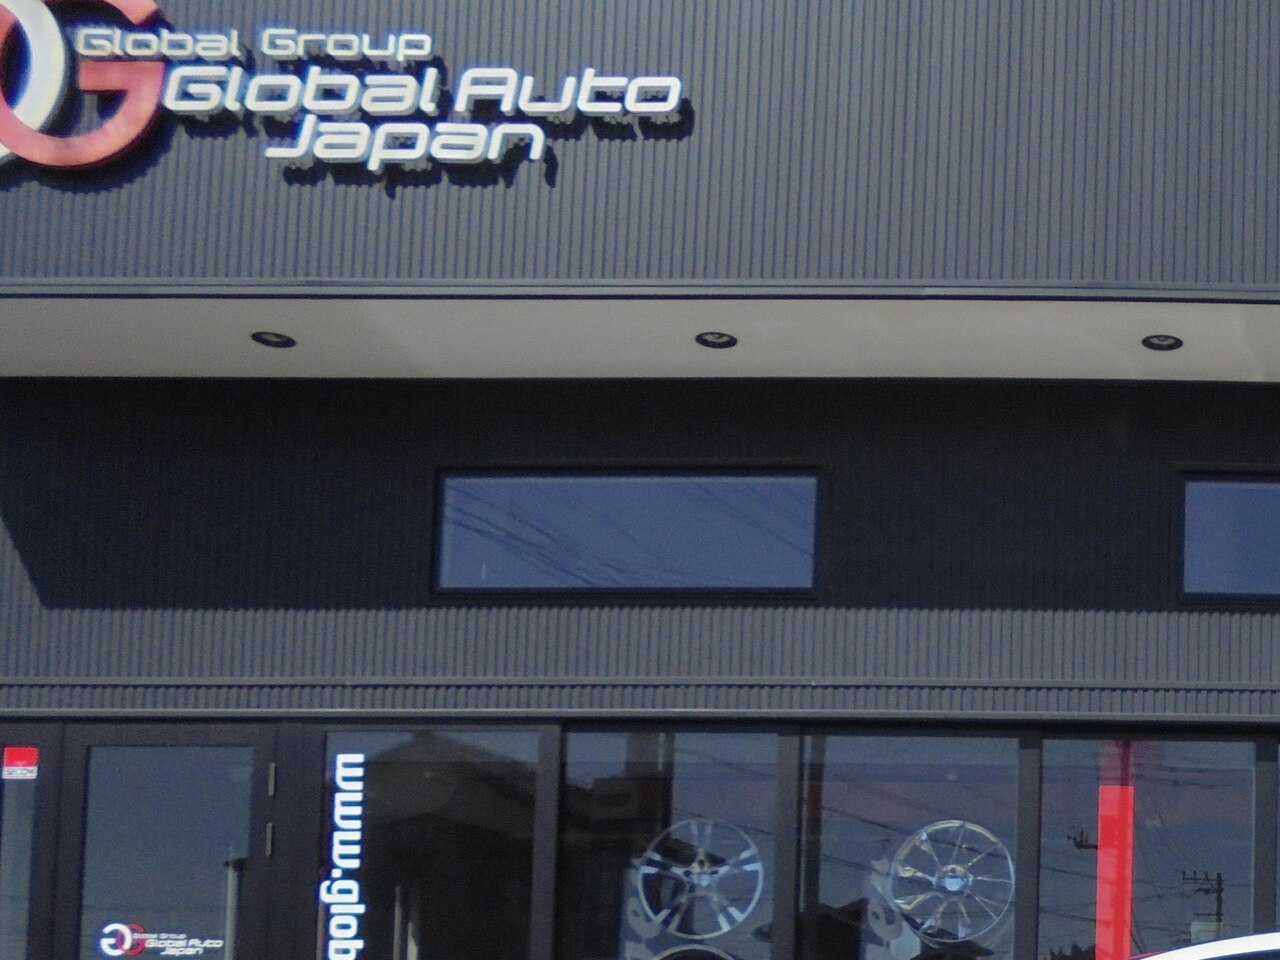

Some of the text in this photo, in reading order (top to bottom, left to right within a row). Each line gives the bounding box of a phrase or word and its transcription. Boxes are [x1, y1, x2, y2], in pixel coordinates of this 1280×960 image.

[75, 27, 432, 62] Global Group
[163, 65, 682, 113] Global Auto
[265, 115, 547, 171] Japan
[145, 938, 224, 948] Global Auto
[160, 947, 204, 956] Japan
